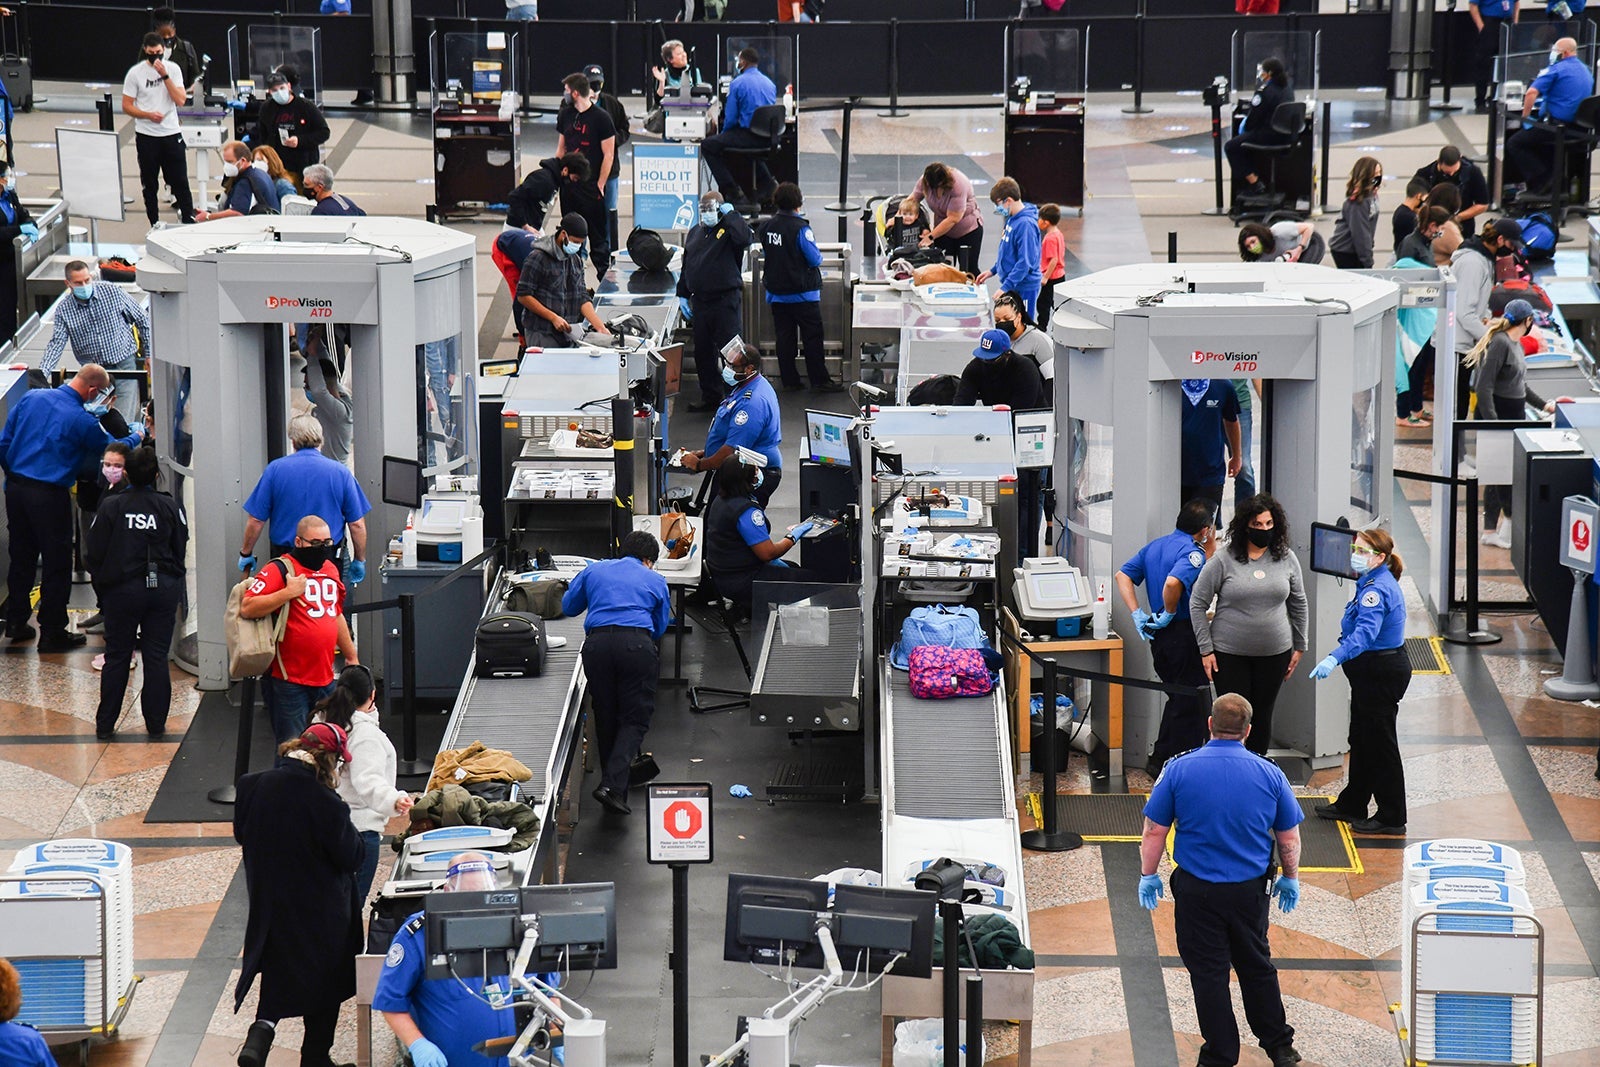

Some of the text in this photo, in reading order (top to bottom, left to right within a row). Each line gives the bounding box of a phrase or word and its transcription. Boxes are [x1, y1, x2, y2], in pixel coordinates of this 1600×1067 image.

[640, 160, 691, 169] EMPTY IT
[640, 171, 691, 181] HOLD IT
[640, 183, 691, 192] REFILL IT
[767, 232, 782, 246] TSA
[280, 297, 332, 307] ProVision
[310, 308, 332, 317] ATD
[620, 355, 626, 368] 5
[1233, 362, 1257, 371] ATD
[863, 426, 870, 440] 6
[125, 513, 157, 530] TSA
[305, 578, 338, 618] 99
